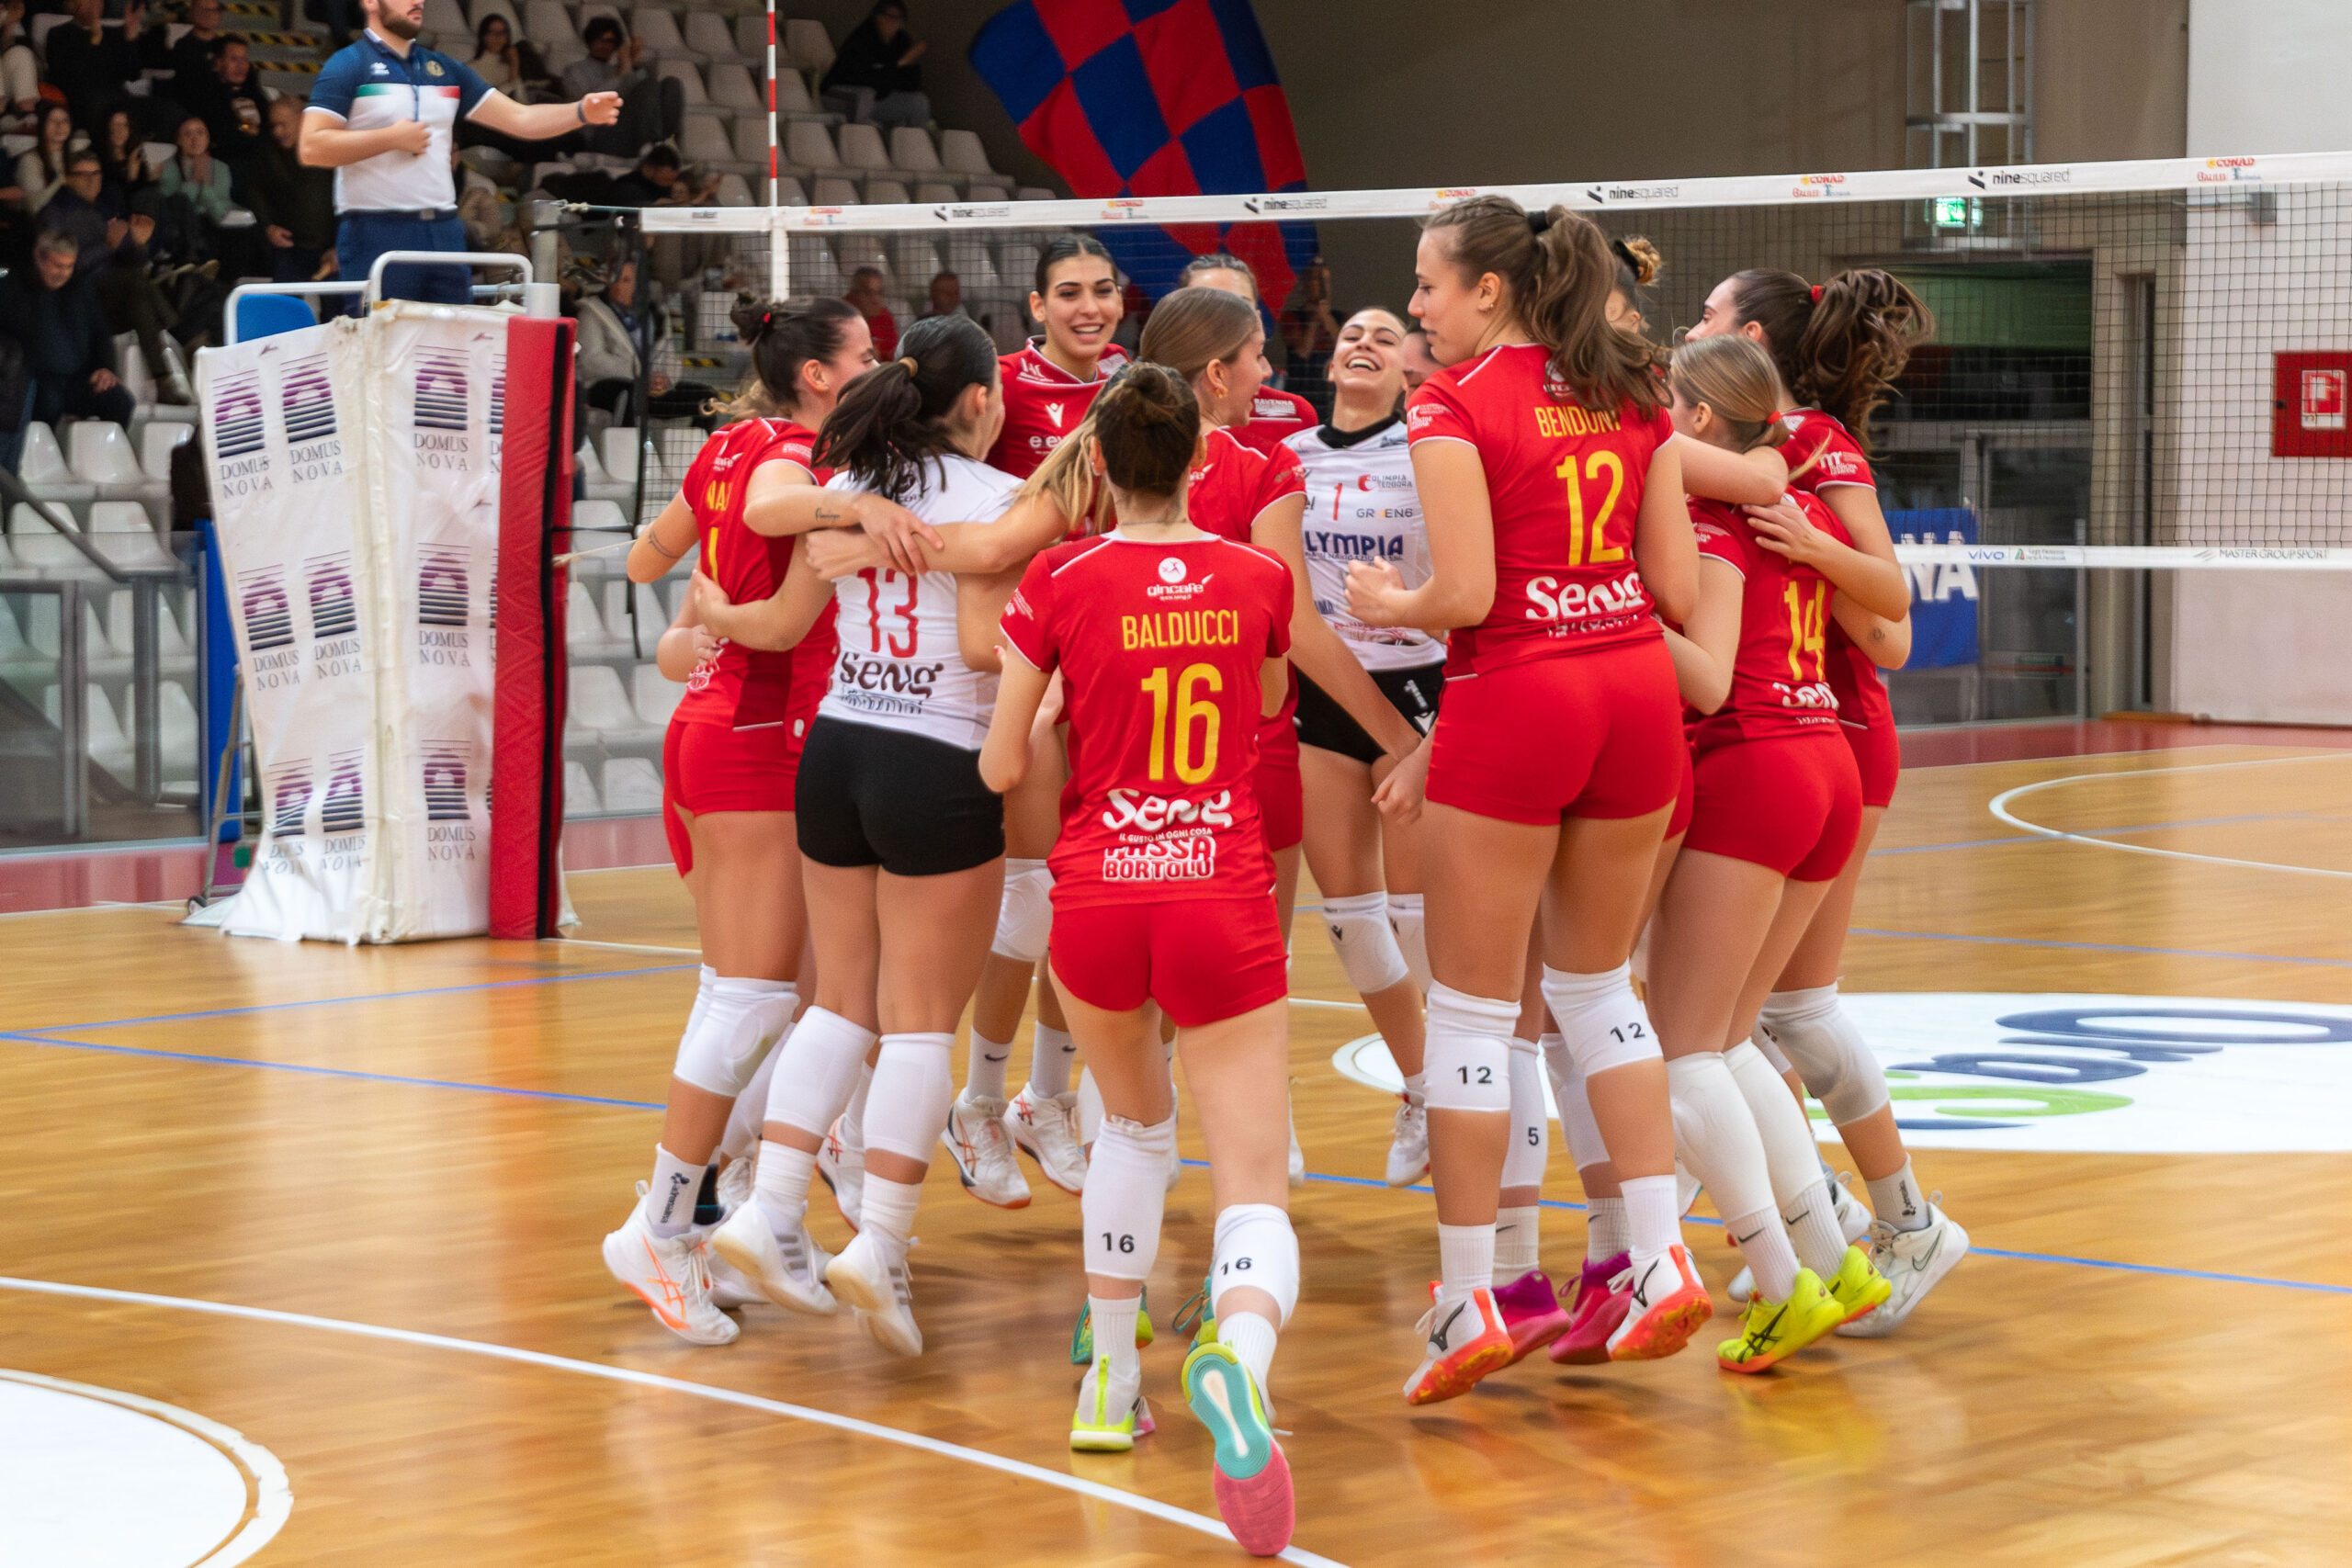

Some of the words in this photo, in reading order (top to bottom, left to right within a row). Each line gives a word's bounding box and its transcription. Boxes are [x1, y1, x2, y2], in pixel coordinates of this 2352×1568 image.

[1992, 169, 2069, 185] ninesquared
[1609, 186, 1679, 201] ninesquared
[289, 440, 342, 465] DOMUS
[413, 433, 469, 453] DOMUS
[220, 455, 270, 479] DOMUS
[292, 460, 343, 483] NOVA
[415, 452, 469, 471] NOVA
[222, 476, 273, 499] NOVA
[1333, 482, 1343, 521] 1
[1555, 450, 1624, 567] 12
[1304, 530, 1404, 556] LYMPIA
[1968, 547, 2006, 560] vivo
[2219, 548, 2257, 559] MASTER
[857, 566, 919, 659] 13
[419, 630, 469, 649] DOMUS
[1121, 610, 1238, 650] BALDUCCI
[1783, 580, 1826, 682] 14
[314, 637, 361, 660] DOMUS
[419, 649, 471, 667] NOVA
[253, 649, 300, 672] DOMUS
[316, 658, 362, 680] NOVA
[256, 670, 300, 691] NOVA
[1140, 662, 1224, 785] 16
[427, 826, 477, 842] DOMUS
[1127, 833, 1154, 843] GUSTO
[1155, 832, 1165, 841] IN
[1165, 829, 1189, 840] OGNI
[1190, 827, 1213, 836] COSA
[427, 844, 476, 861] NOVA
[1611, 1021, 1646, 1043] 12
[1457, 1066, 1493, 1085] 12
[1527, 1126, 1540, 1146] 5
[1102, 1232, 1136, 1254] 16
[1220, 1256, 1253, 1276] 16
